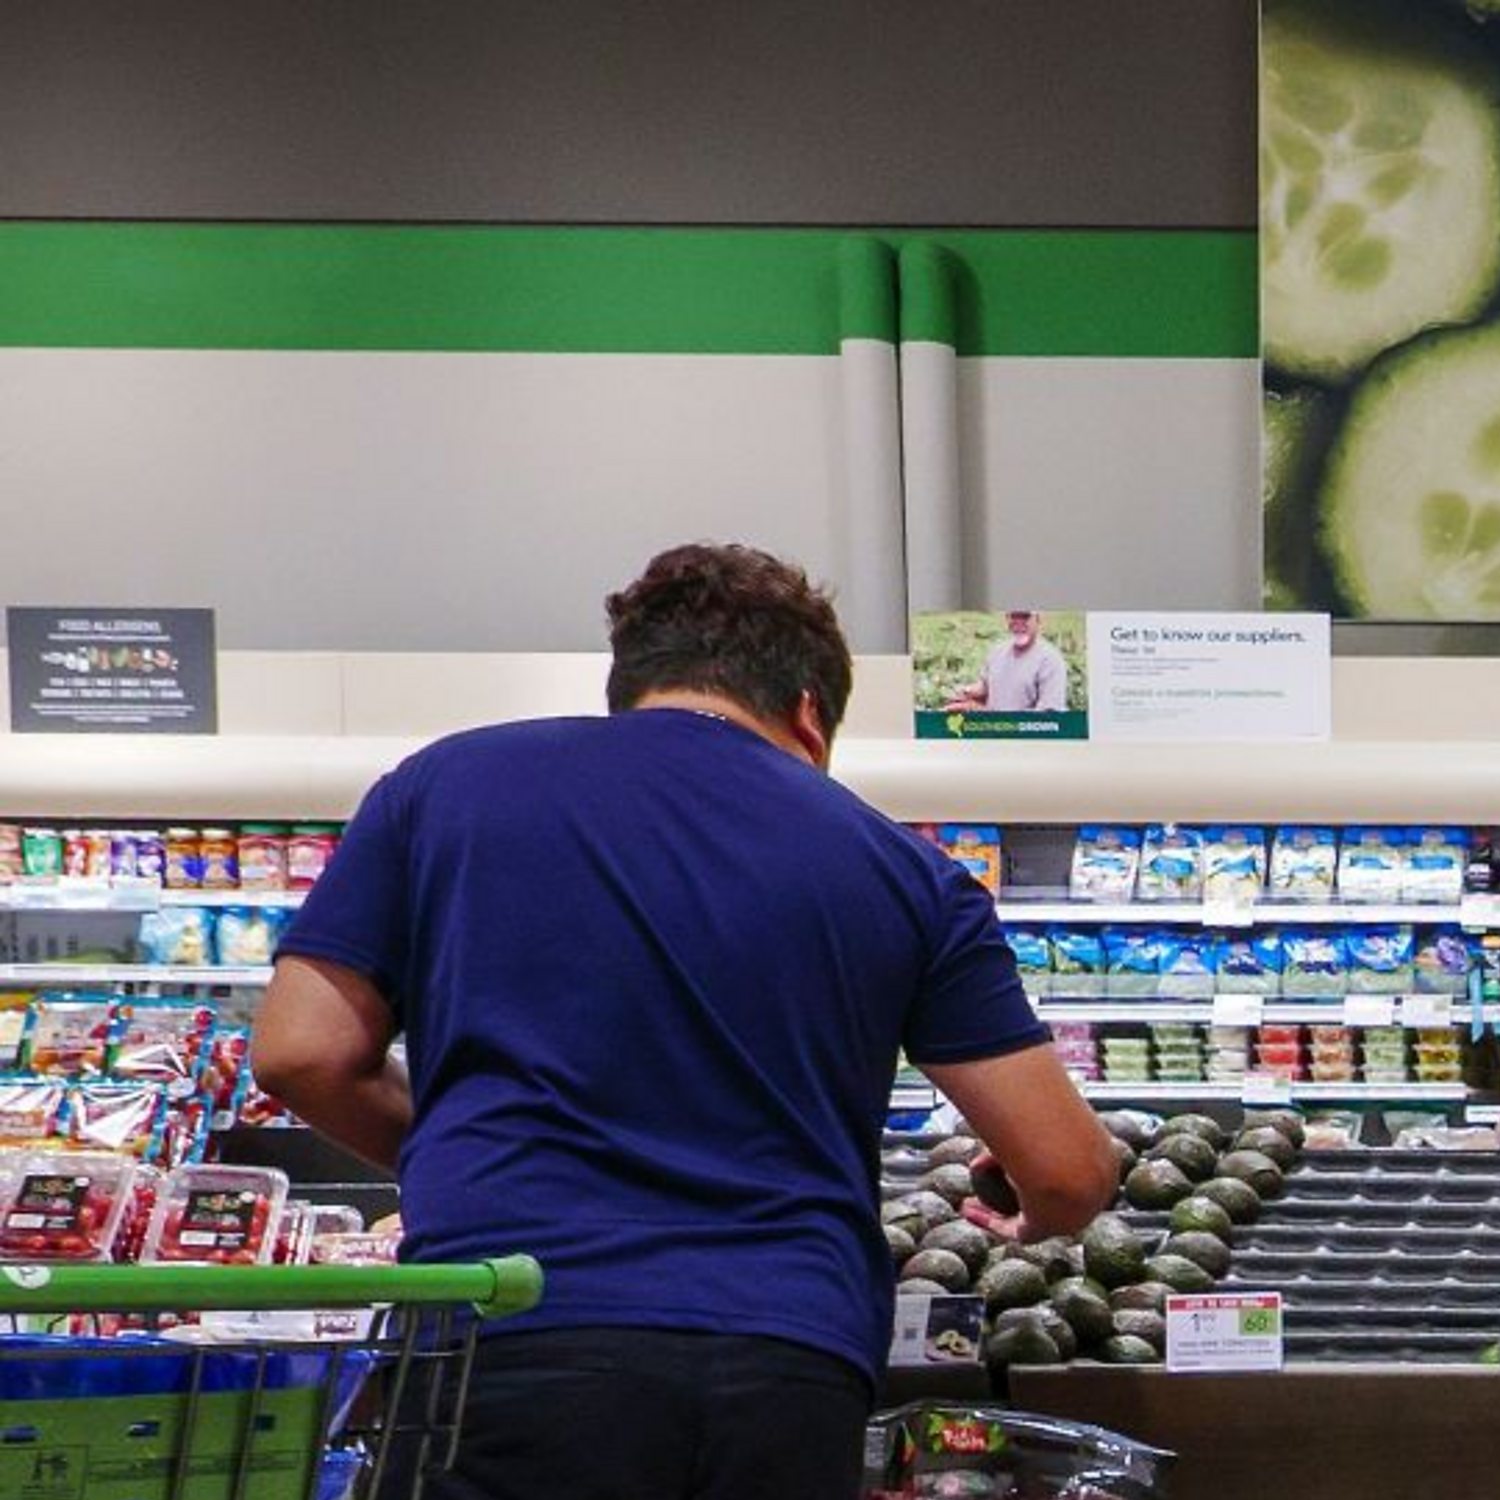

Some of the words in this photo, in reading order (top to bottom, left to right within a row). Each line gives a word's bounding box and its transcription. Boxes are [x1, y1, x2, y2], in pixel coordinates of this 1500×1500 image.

[1110, 626, 1139, 642] Get
[1142, 628, 1158, 641] to
[1162, 626, 1203, 641] know
[1207, 630, 1232, 642] our
[1235, 627, 1306, 644] suppliers.
